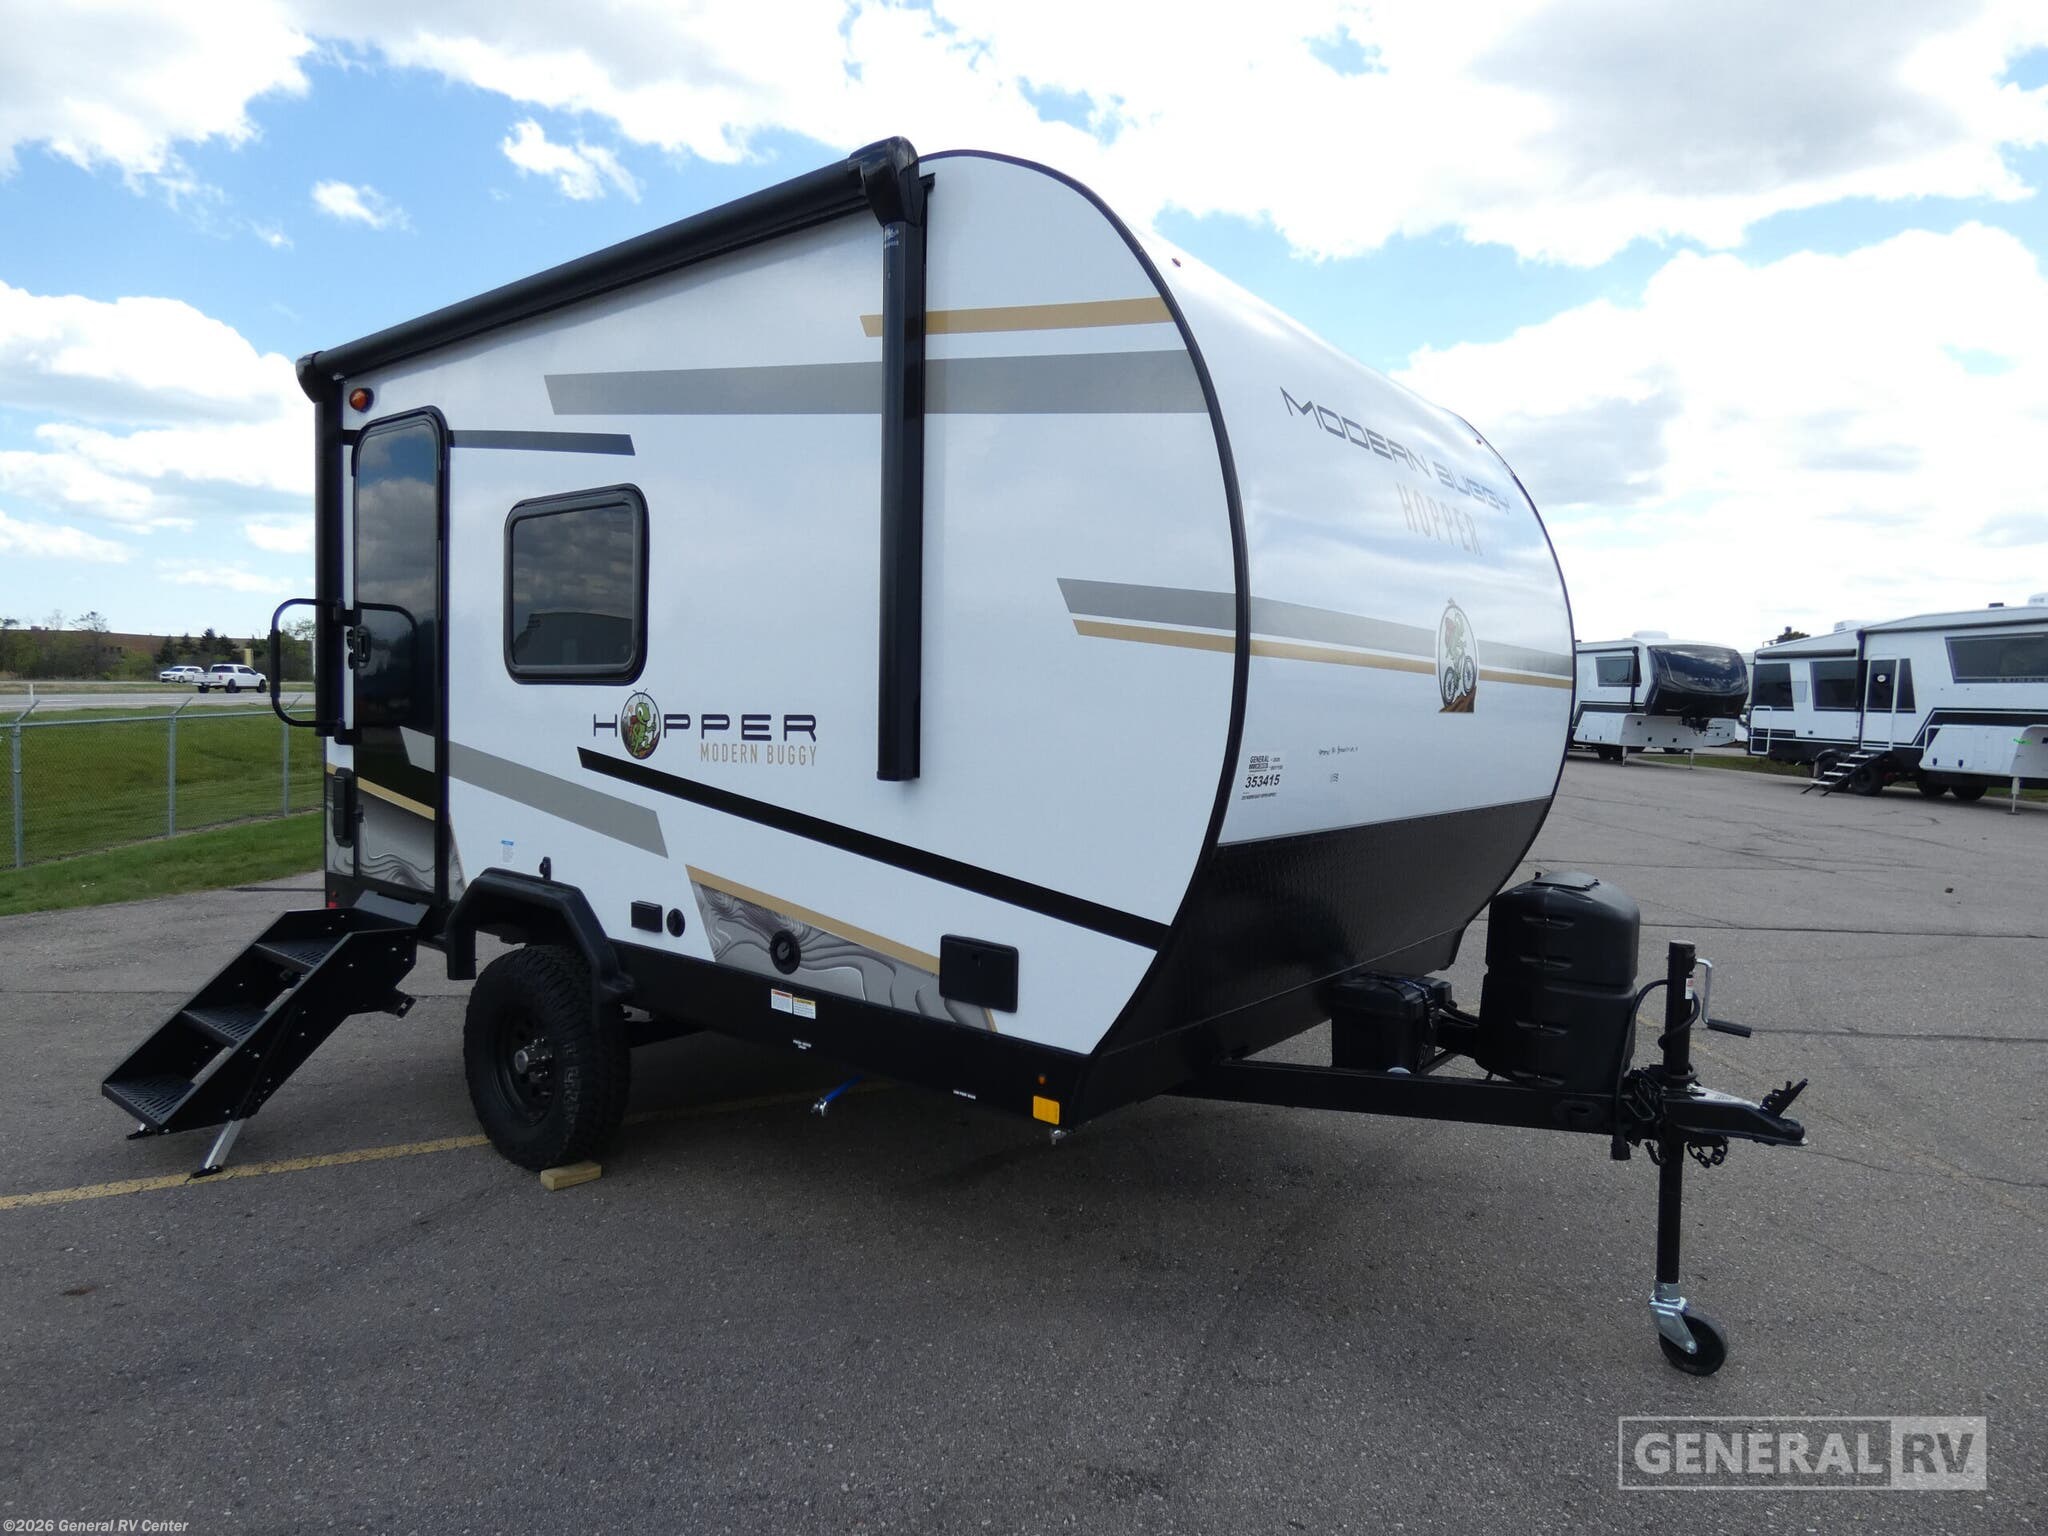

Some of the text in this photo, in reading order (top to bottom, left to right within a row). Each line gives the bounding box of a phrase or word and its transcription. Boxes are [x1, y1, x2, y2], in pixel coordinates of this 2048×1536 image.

[1280, 386, 1511, 515] MODERN BUGGY
[1396, 482, 1483, 556] HOPPER
[700, 743, 817, 766] MODERN BUGGY
[1245, 774, 1280, 788] 353415
